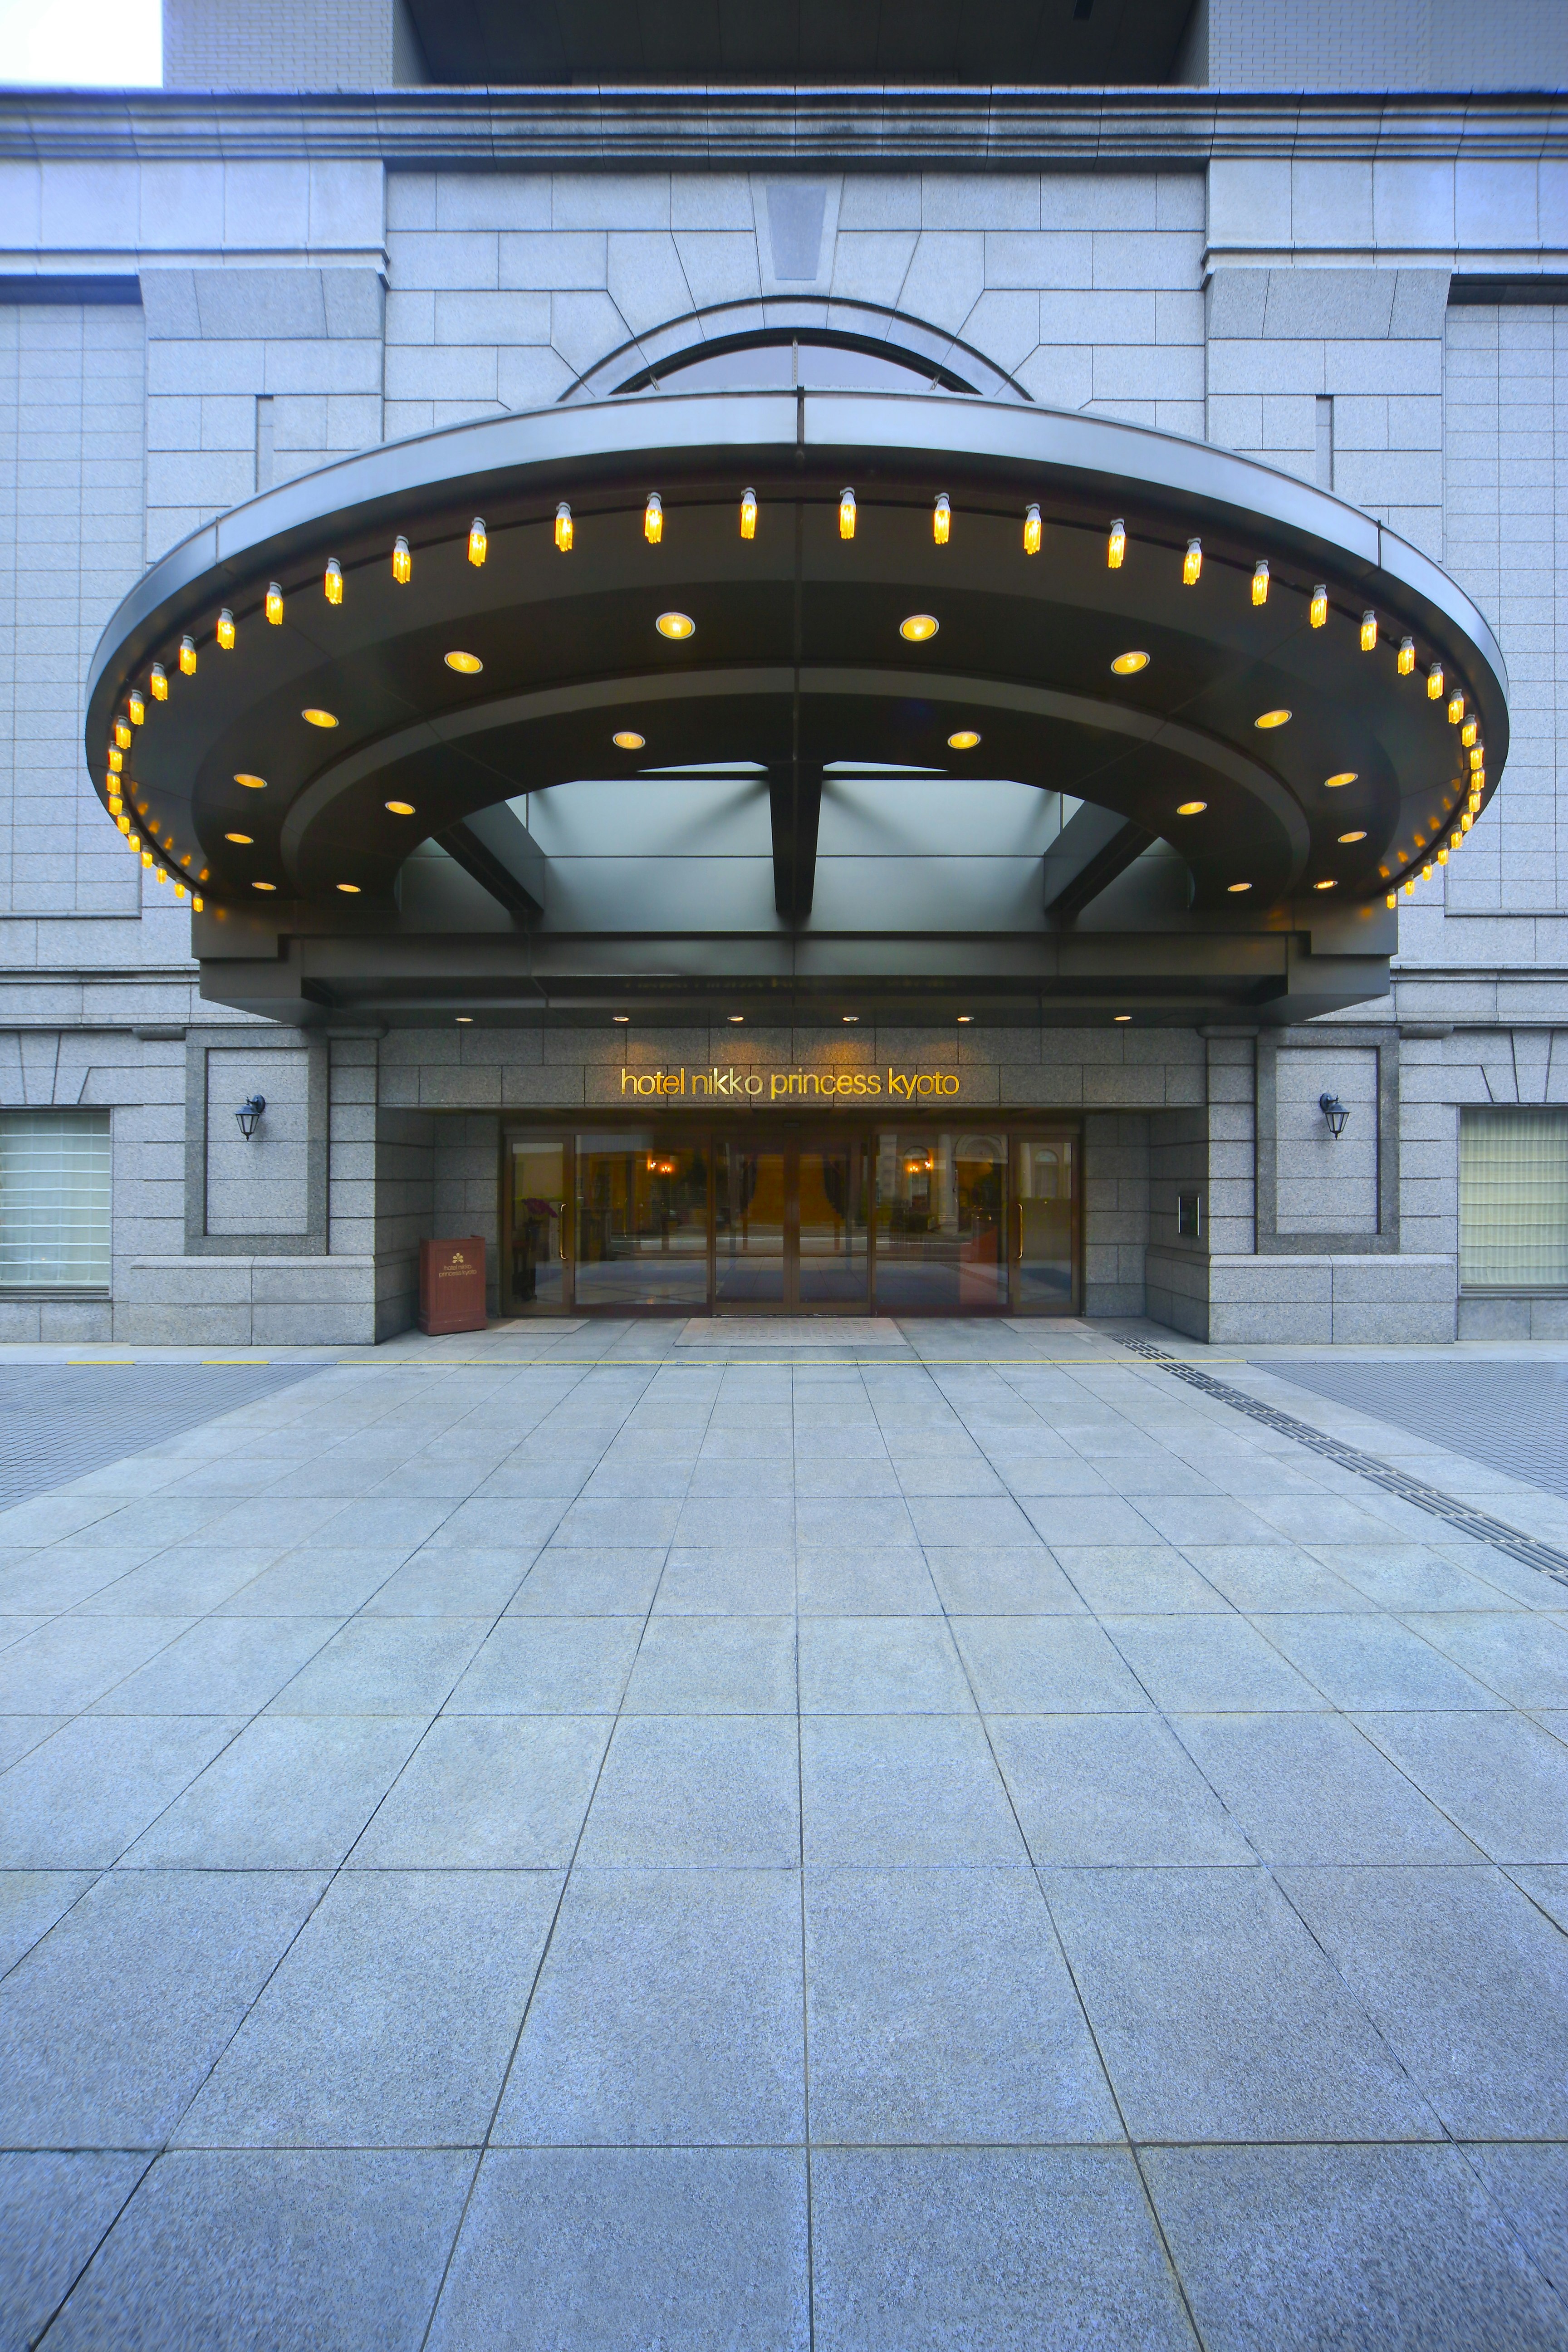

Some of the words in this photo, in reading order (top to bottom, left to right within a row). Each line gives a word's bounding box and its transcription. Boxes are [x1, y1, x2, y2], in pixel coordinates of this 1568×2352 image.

[621, 1068, 685, 1095] hotel
[692, 1068, 763, 1095] nikko
[771, 1068, 882, 1100] princess
[888, 1067, 960, 1100] kyoto
